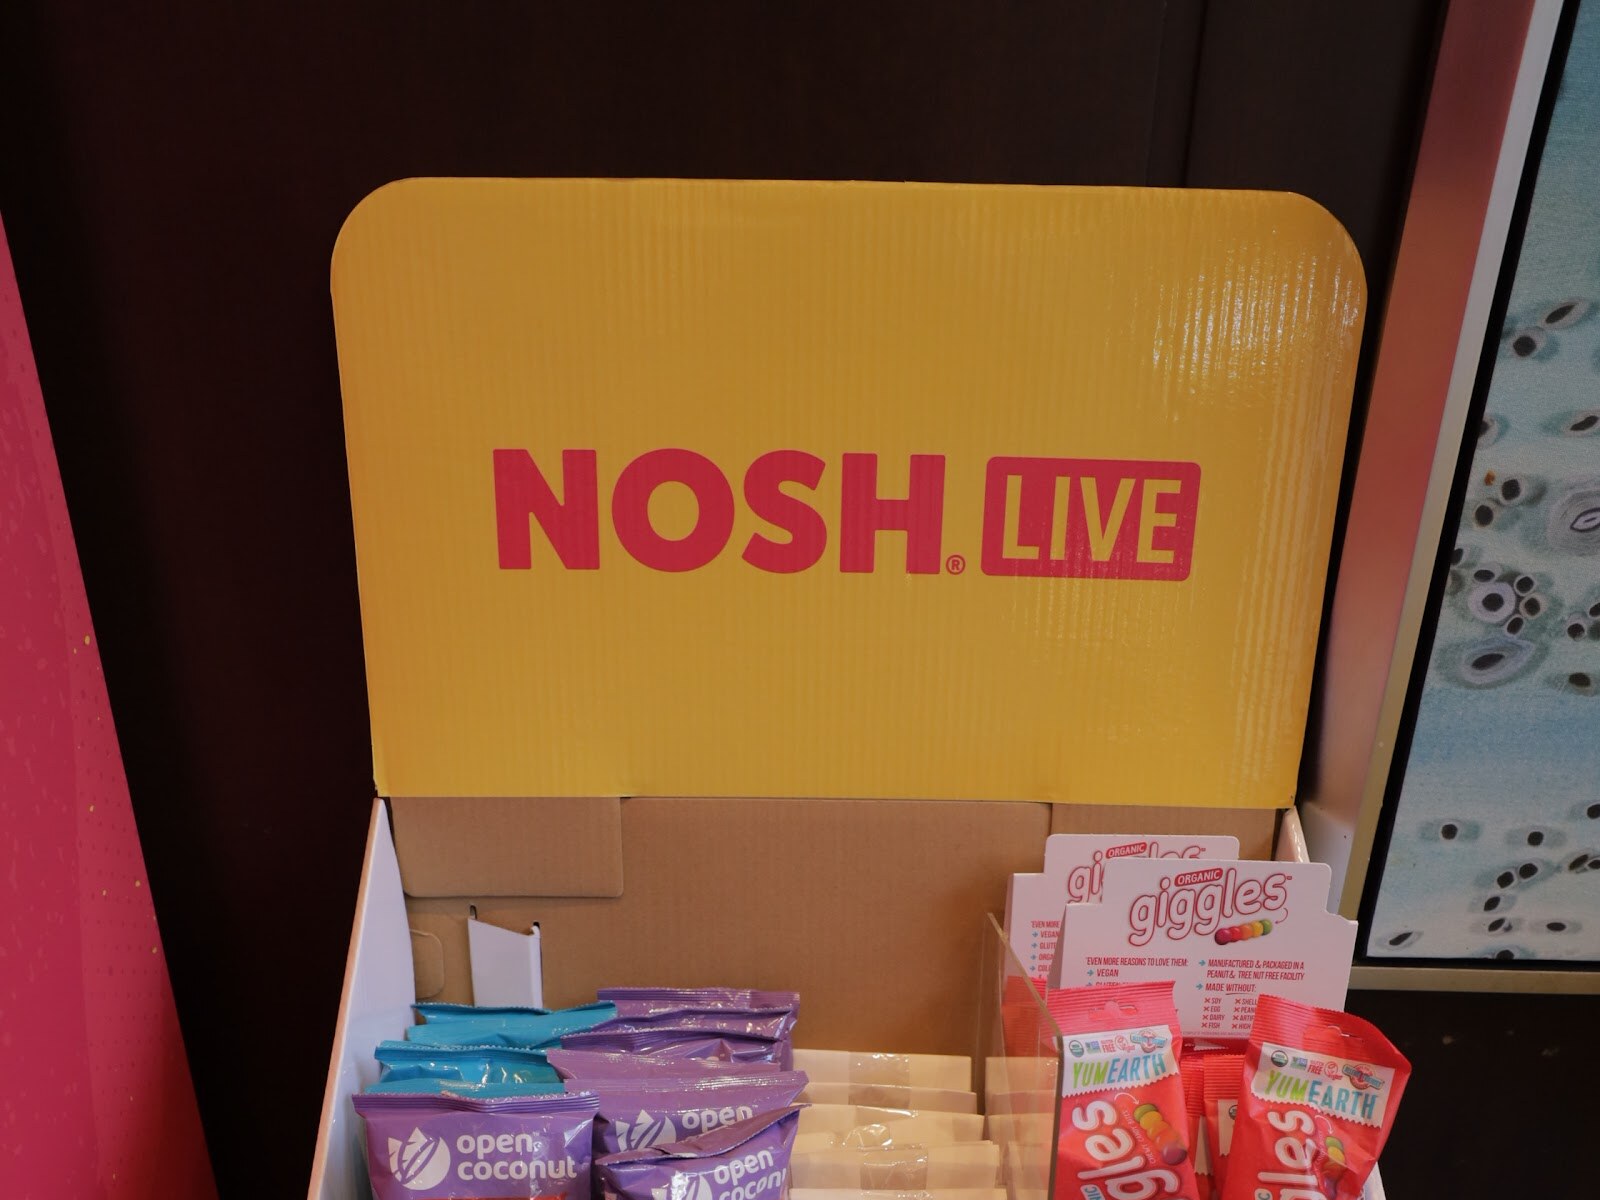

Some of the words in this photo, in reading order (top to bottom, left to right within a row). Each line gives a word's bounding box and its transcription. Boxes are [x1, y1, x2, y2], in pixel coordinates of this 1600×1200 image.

[1001, 474, 1183, 564] LIVE
[1107, 843, 1146, 858] ORGANIC
[1176, 869, 1221, 886] ORGANIC
[1128, 867, 1288, 947] giggles
[1103, 957, 1119, 966] MORE
[1120, 957, 1147, 966] REASONS
[1147, 958, 1155, 966] TO
[1155, 958, 1169, 967] LOVE
[1207, 959, 1254, 968] MANUFACTURED
[1254, 960, 1261, 968] &
[1262, 960, 1292, 970] PACKAGED
[1293, 961, 1299, 970] IN
[1299, 962, 1305, 970] A
[1096, 968, 1119, 977] VEGAN
[1206, 970, 1229, 979] PEANUT
[1229, 971, 1236, 979] &
[1237, 971, 1252, 979] TREE
[1253, 971, 1265, 980] NUT
[1265, 971, 1280, 980] FREE
[1279, 972, 1305, 980] FACILITY
[1205, 983, 1225, 992] MADE
[1225, 984, 1257, 993] WITHOUT:
[1073, 1053, 1167, 1089] YUMEARTH
[1307, 1064, 1323, 1076] FREE
[1264, 1070, 1378, 1120] YUMEARTH
[456, 1133, 533, 1160] open
[457, 1155, 578, 1181] coconut
[713, 1149, 774, 1186] open
